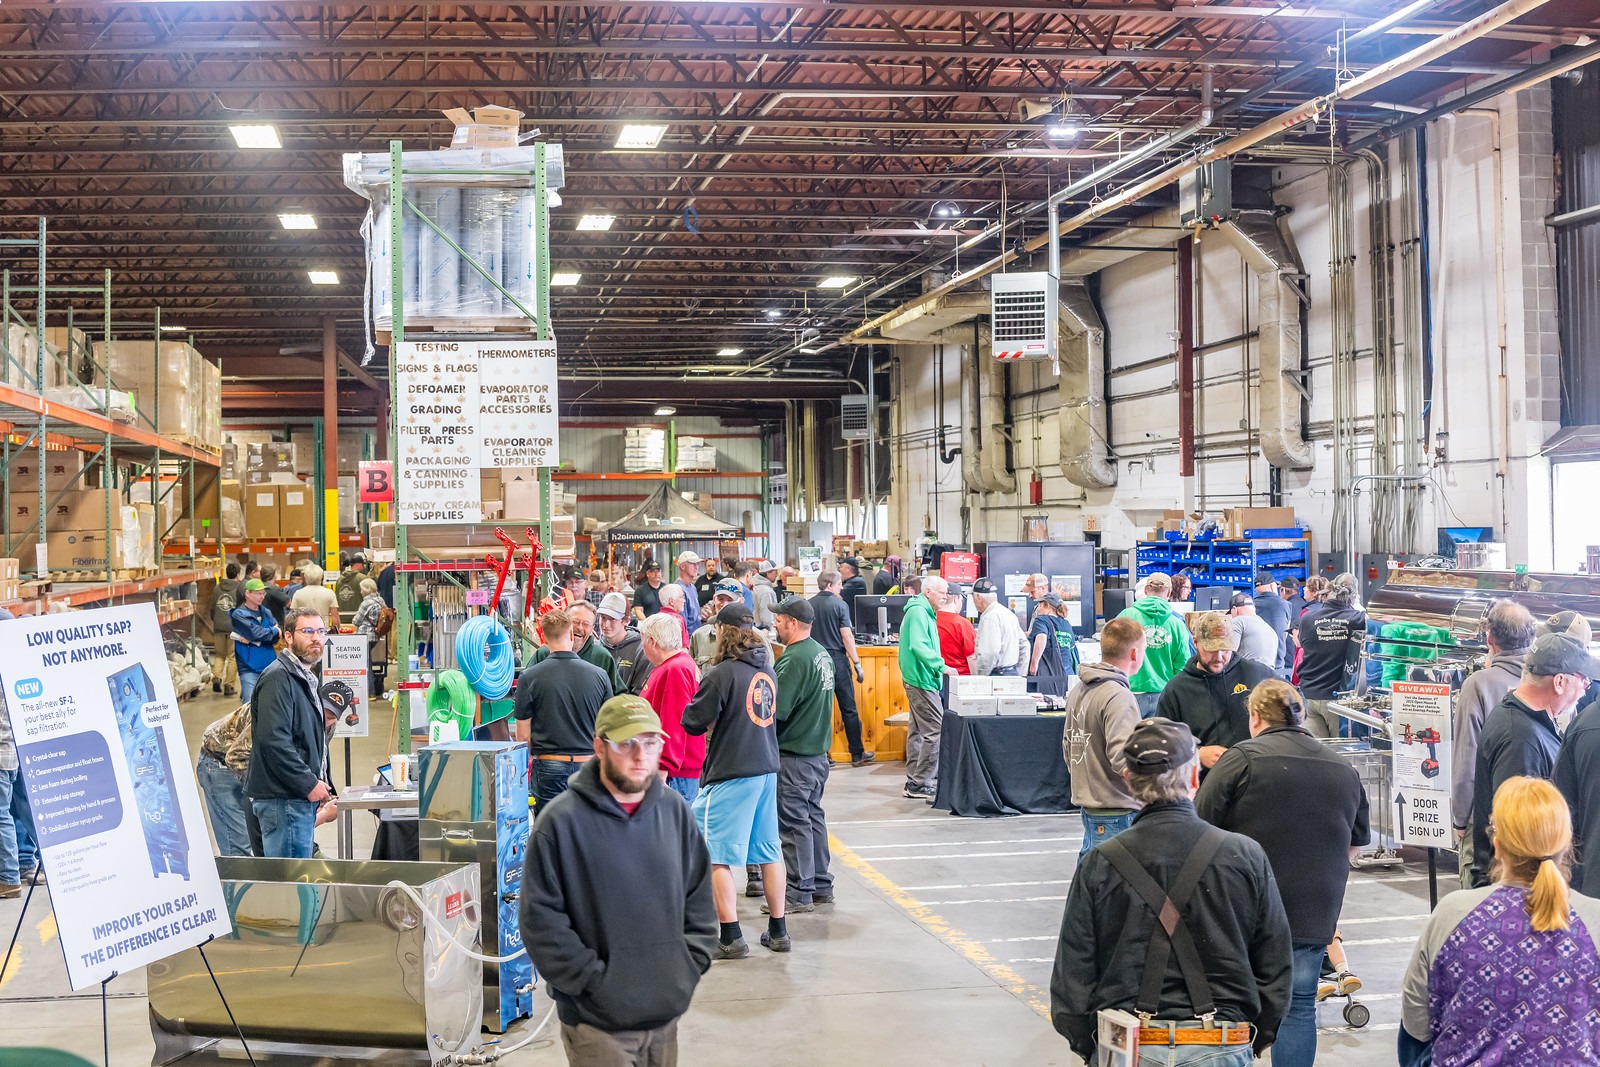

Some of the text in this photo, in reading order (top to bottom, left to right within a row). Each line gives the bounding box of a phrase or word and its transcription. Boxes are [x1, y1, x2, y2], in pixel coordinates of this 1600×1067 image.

[415, 344, 458, 352] TESTING
[478, 349, 556, 358] THERMOMETERS
[398, 364, 478, 372] SIGNS & FLAGS
[408, 385, 465, 393] DEFOAMER
[480, 385, 548, 393] EVAPORATOR
[410, 405, 461, 414] GRADING
[480, 405, 552, 413] ACCESSORIES
[400, 426, 474, 434] FILTER PRESS
[422, 436, 454, 444] PARTS
[484, 438, 552, 446] EVAPORATOR
[492, 448, 546, 456] CLEANING
[406, 456, 470, 465] PACKAGING
[494, 458, 543, 466] SUPPLIES
[404, 470, 467, 478] & CANNING
[366, 470, 388, 492] B
[413, 480, 464, 488] SUPPLIES
[400, 501, 480, 510] CANDY CREAM
[414, 511, 464, 520] SUPPLIES
[27, 620, 131, 646] LOW QUALITY SAP?
[42, 642, 127, 667] NOT ANYMORE.
[17, 682, 39, 696] NEW
[1399, 686, 1443, 694] GIVEAWAY
[22, 696, 75, 712] The all-new SF-2,
[146, 705, 162, 714] Perfect
[24, 707, 77, 726] your best ally for
[148, 713, 170, 723] hobbyists!
[27, 721, 69, 736] sap filtration.
[32, 752, 58, 762] Crystal-clear
[52, 763, 74, 773] evaporator
[136, 765, 155, 776] SF-2
[60, 777, 73, 786] during
[74, 774, 87, 783] boiling
[42, 794, 62, 805] Extended
[70, 790, 85, 798] storage
[46, 809, 64, 819] Improves
[65, 805, 81, 814] filtering
[101, 797, 116, 806] presses
[1413, 798, 1438, 809] DOOR
[1413, 812, 1439, 823] PRIZE
[49, 823, 69, 833] Stabilized
[80, 817, 91, 825] syrup
[92, 814, 103, 822] grade
[1409, 826, 1445, 837] SIGN UP
[92, 893, 198, 940] IMPROVE YOUR SAP!
[81, 908, 217, 968] THE DIFFERENCE IS CLEAR!
